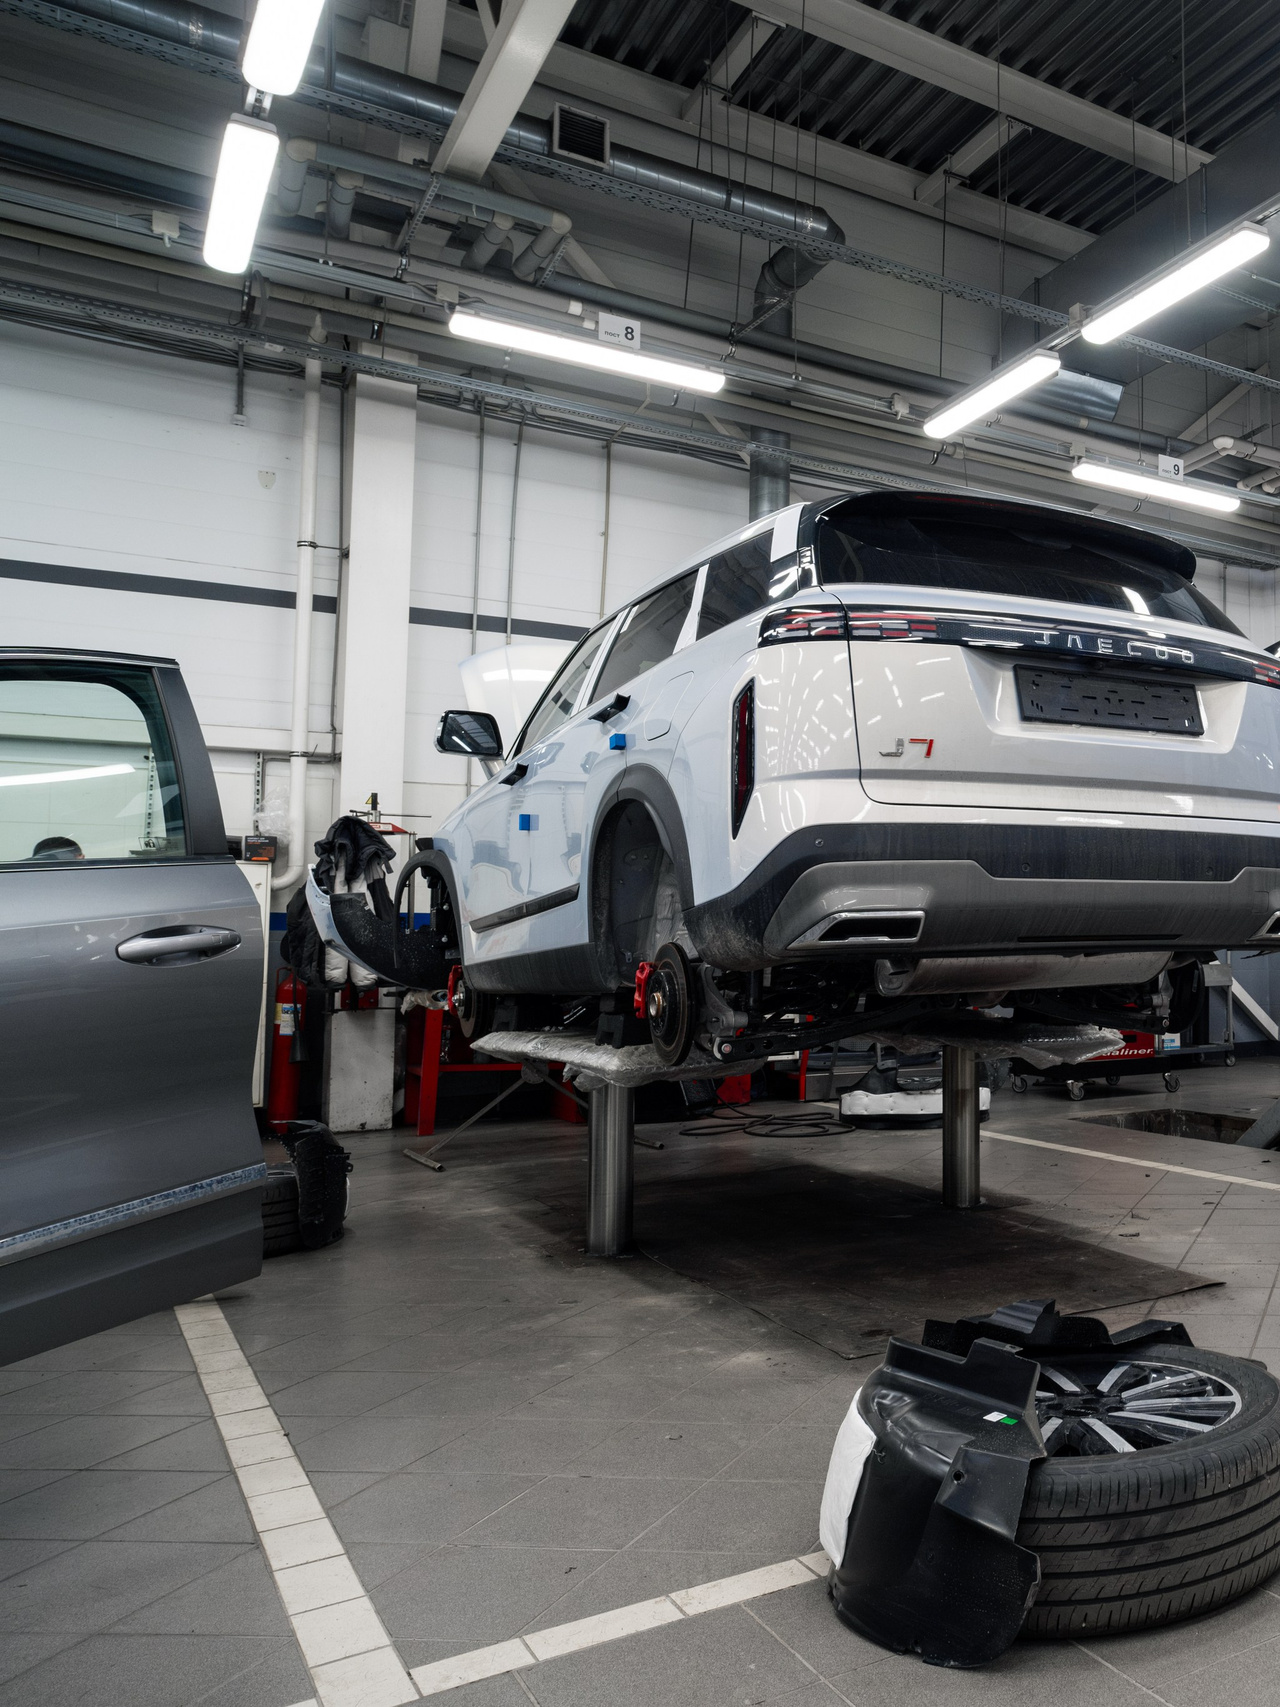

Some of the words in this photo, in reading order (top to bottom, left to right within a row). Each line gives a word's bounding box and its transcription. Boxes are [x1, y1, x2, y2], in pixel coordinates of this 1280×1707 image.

[625, 326, 635, 341] 8
[1173, 464, 1180, 475] 9
[1034, 632, 1195, 664] JAECOO
[879, 738, 934, 758] J7
